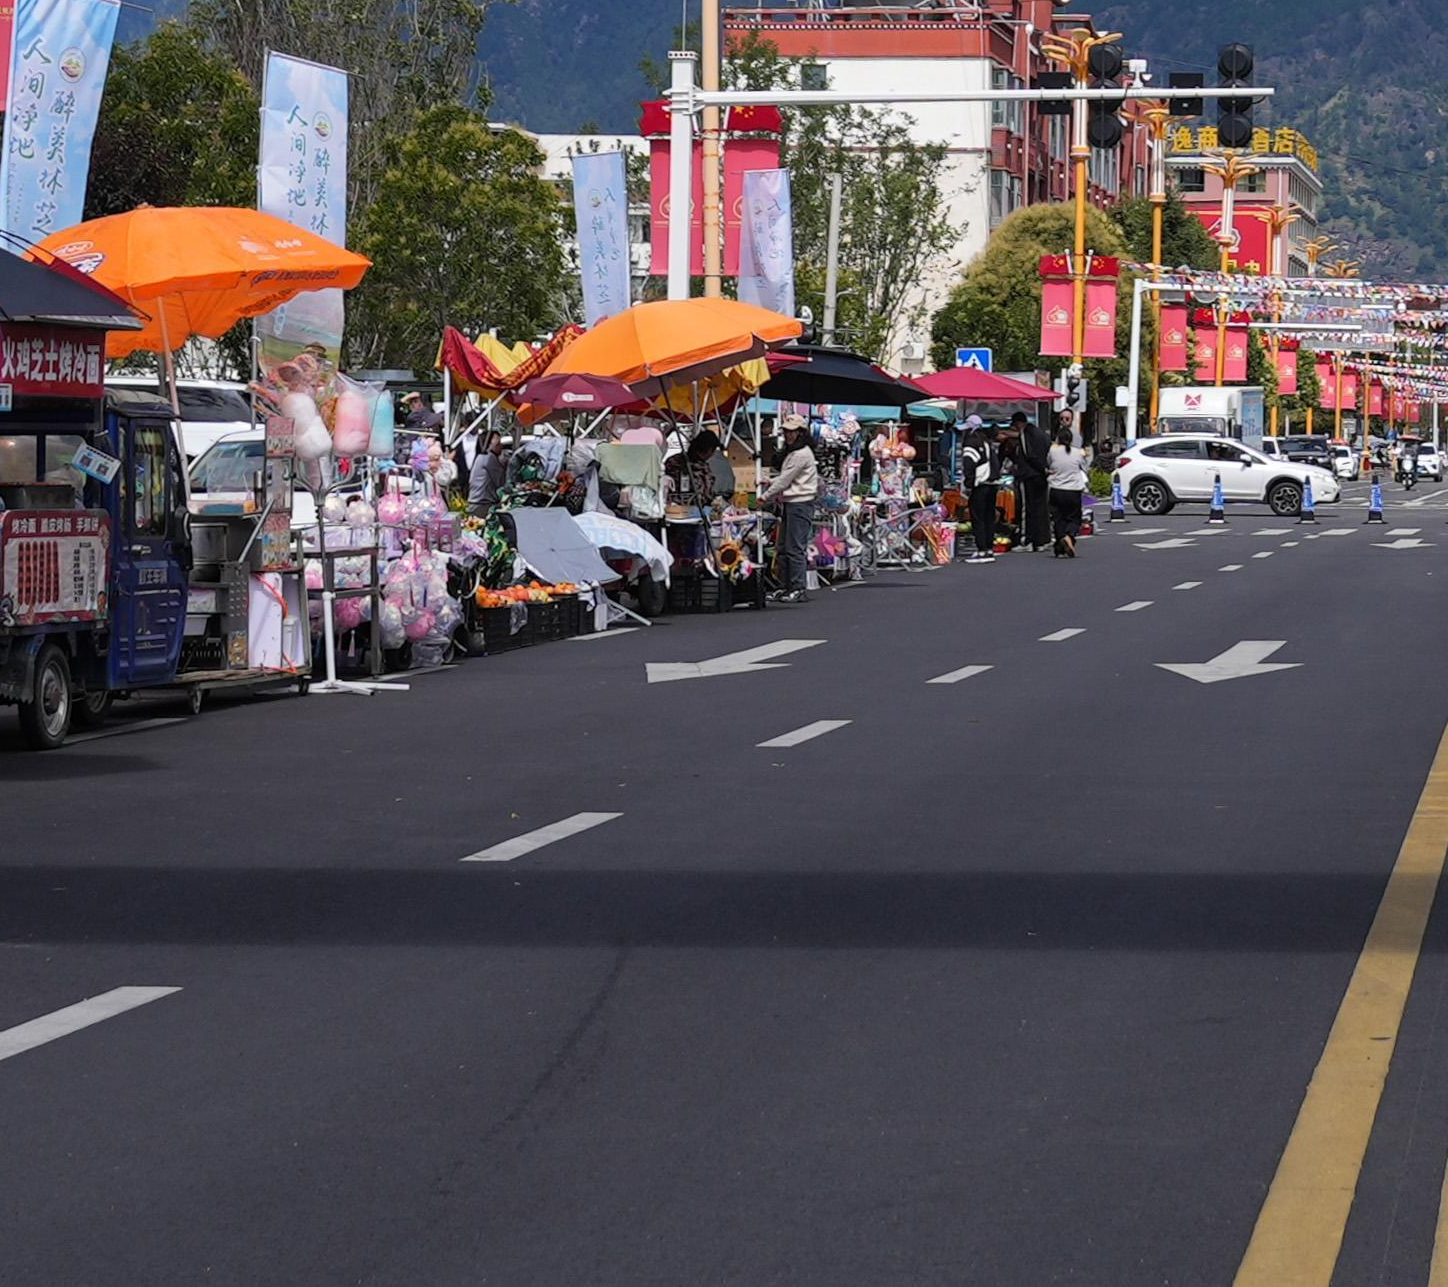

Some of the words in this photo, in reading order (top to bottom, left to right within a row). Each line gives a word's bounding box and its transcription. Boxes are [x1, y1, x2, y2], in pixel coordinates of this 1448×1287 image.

[2, 337, 100, 385] 火鸡芝士烤冷面
